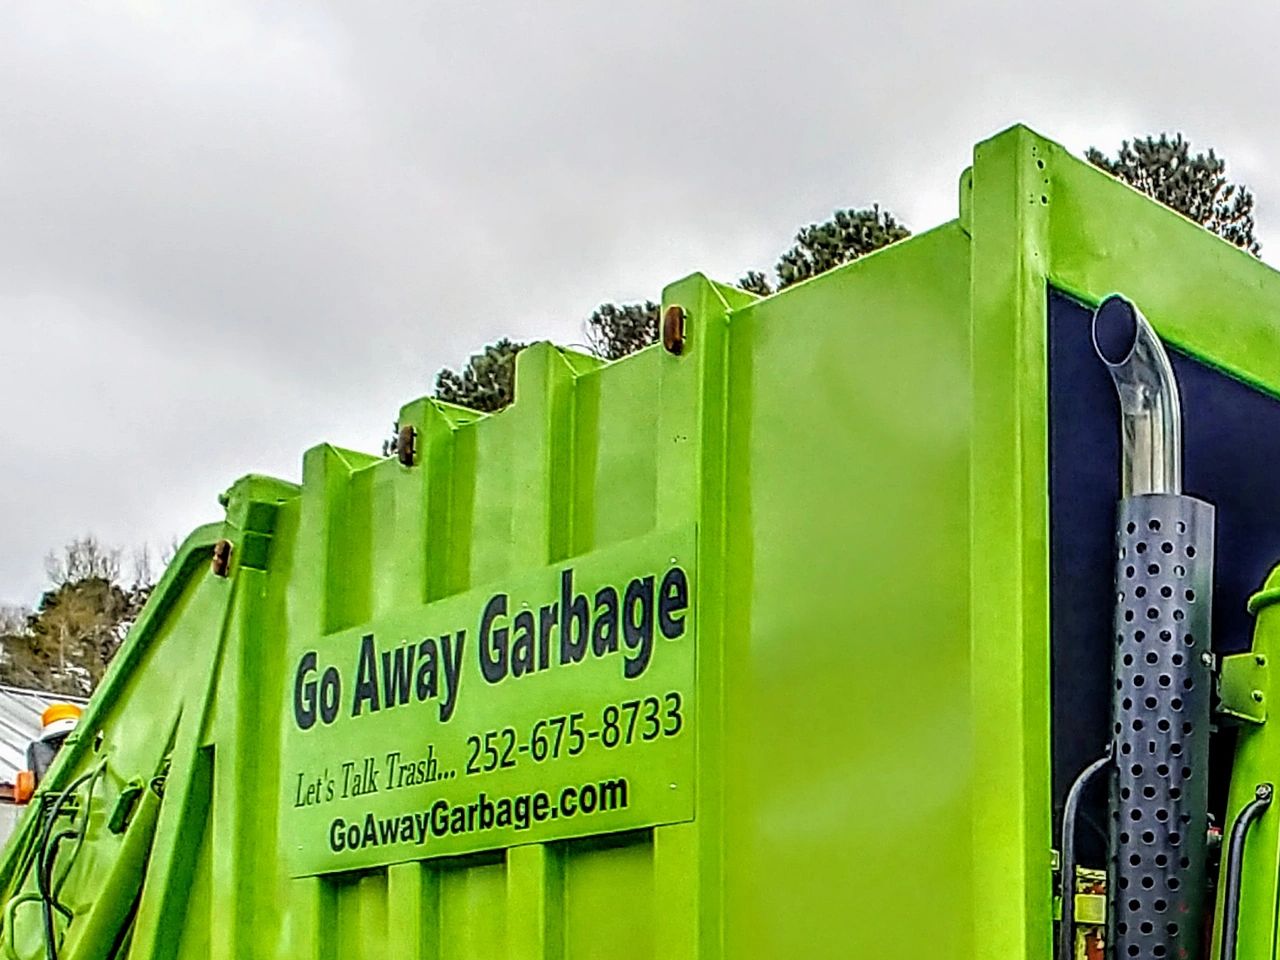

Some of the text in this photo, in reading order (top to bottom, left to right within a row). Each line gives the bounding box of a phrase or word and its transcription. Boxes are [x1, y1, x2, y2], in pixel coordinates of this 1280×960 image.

[294, 565, 691, 730] Go Away Garbage
[294, 691, 683, 808] Let's Talk Trash... 252-675-8733
[329, 777, 629, 853] GoAwayGarbage.com
